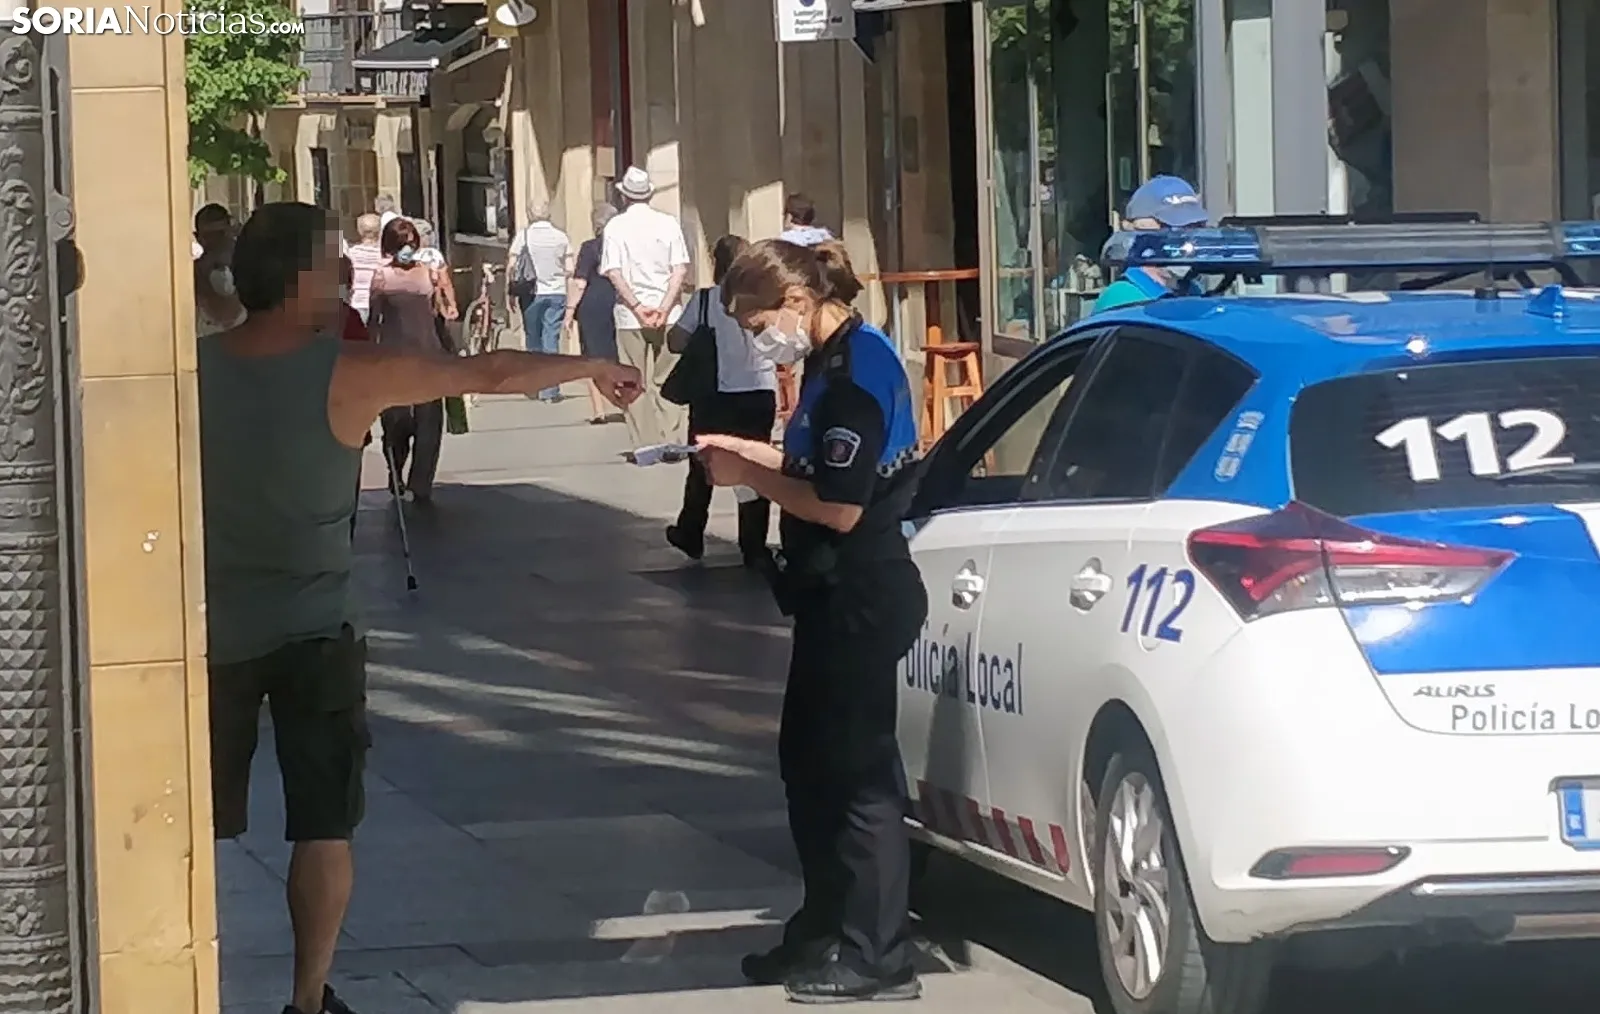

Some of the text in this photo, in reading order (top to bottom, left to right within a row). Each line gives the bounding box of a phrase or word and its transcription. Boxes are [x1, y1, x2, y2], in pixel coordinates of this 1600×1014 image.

[1375, 408, 1574, 482] 112
[1120, 563, 1196, 643] 112
[902, 620, 1024, 717] olicía Local
[1413, 684, 1496, 698] AURIS
[1451, 702, 1555, 731] Policía
